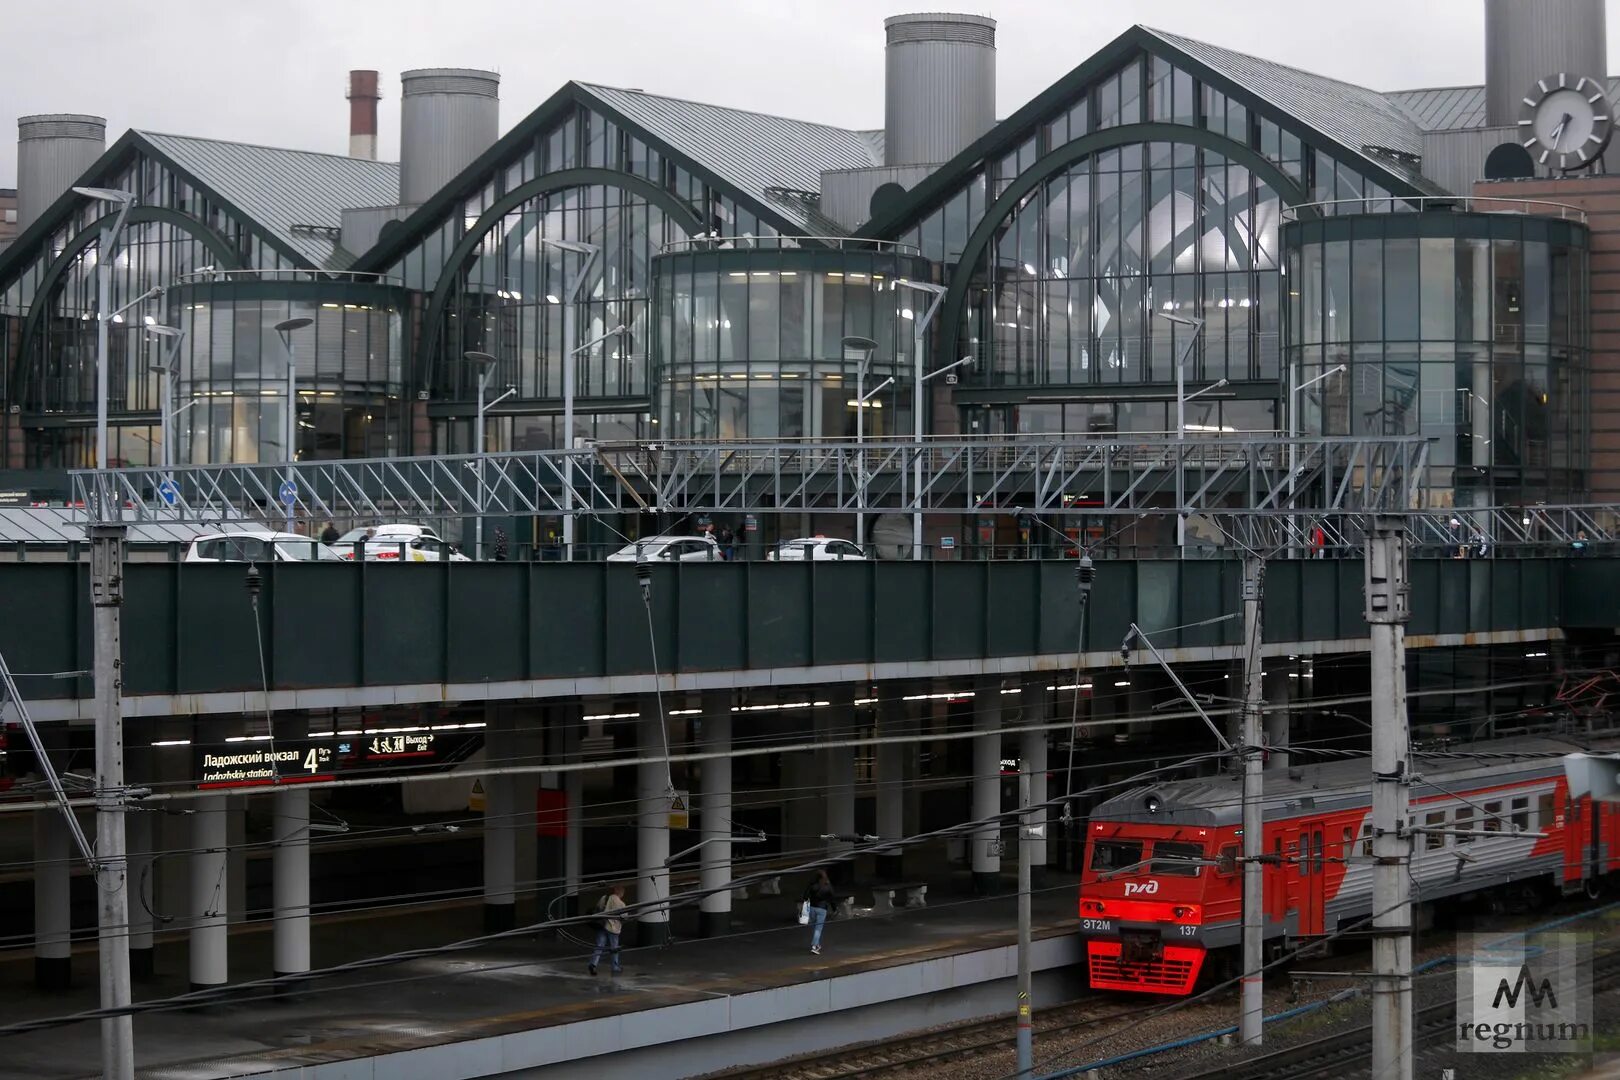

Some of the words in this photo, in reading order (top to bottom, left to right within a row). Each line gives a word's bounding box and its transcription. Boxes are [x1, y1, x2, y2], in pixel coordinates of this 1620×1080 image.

[405, 735, 428, 745] Выход
[417, 744, 428, 752] Exit
[203, 750, 262, 768] Ладожский
[264, 750, 300, 763] вокзал
[303, 748, 318, 774] 4
[246, 768, 274, 779] station
[1083, 919, 1111, 931] ЭТ2М
[1179, 925, 1197, 936] 137
